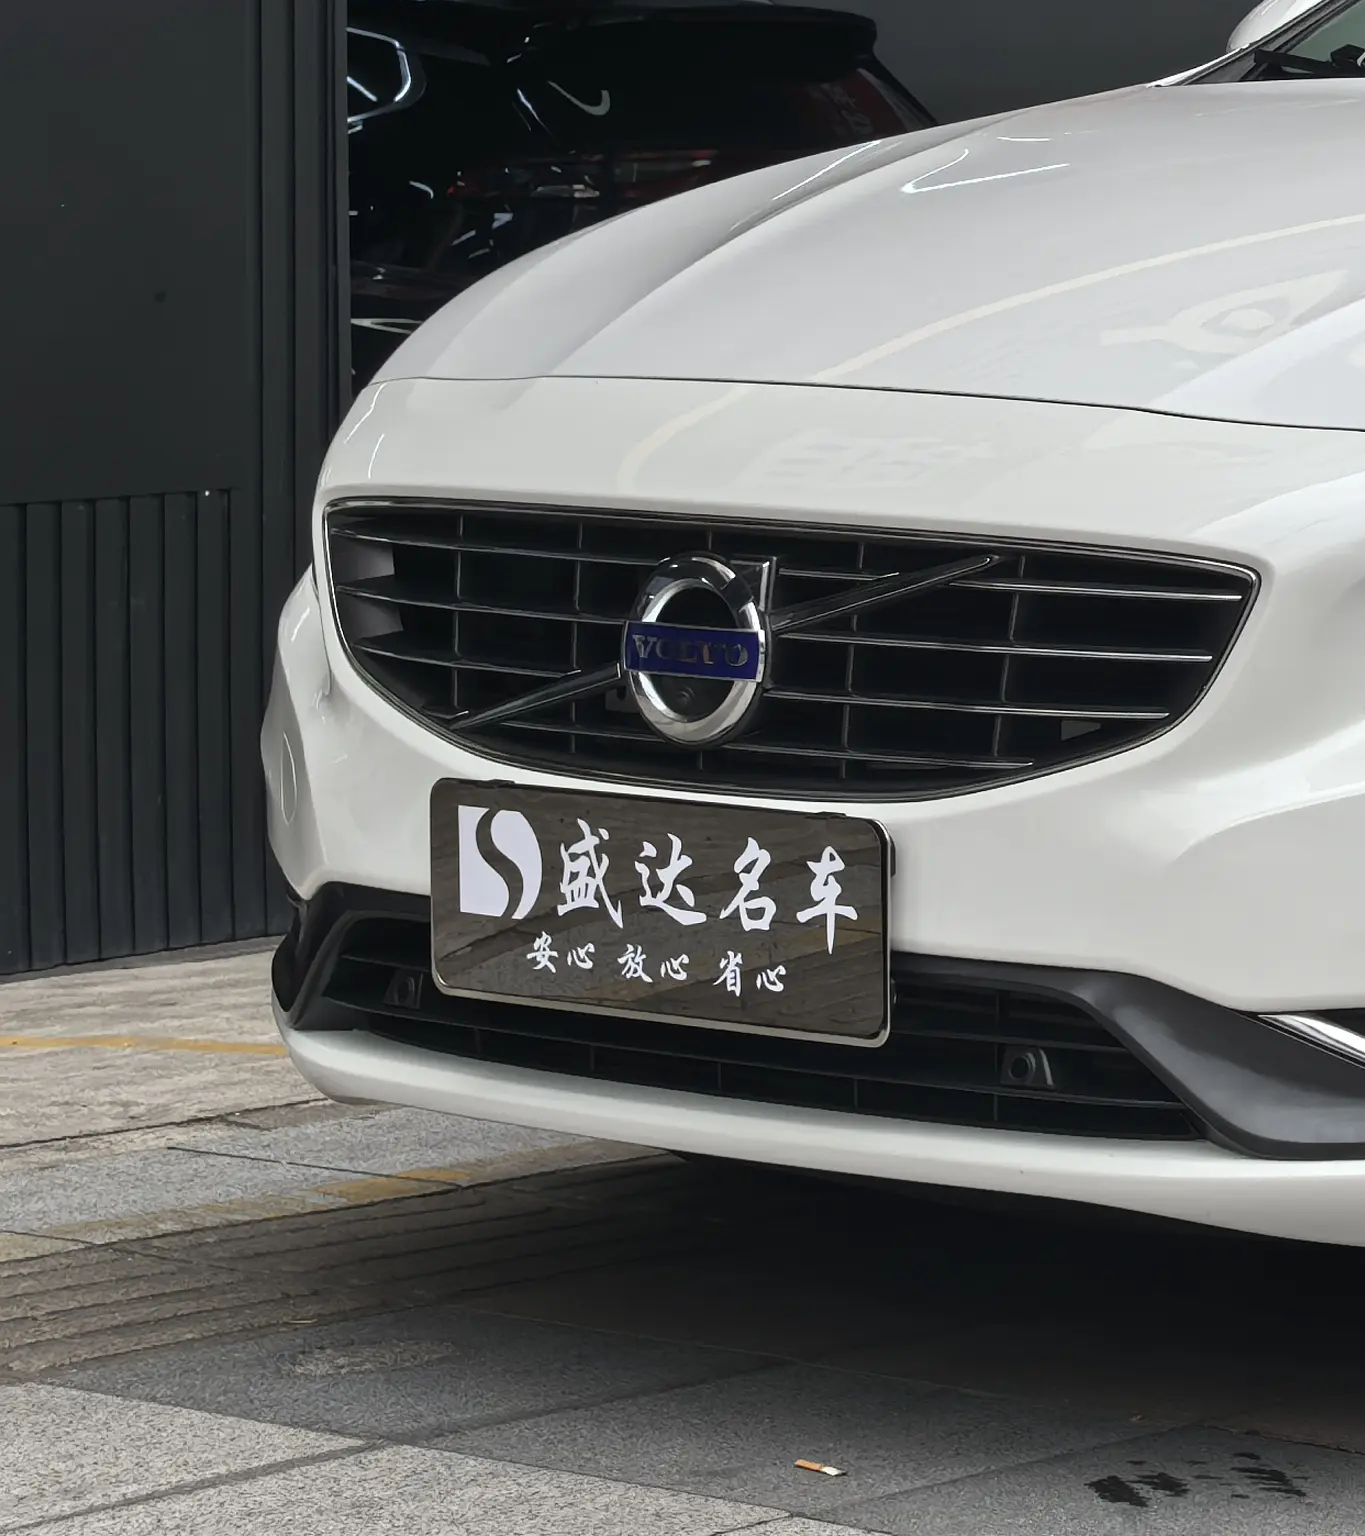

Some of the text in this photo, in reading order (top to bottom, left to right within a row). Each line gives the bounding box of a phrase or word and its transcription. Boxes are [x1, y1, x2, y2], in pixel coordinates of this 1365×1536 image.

[632, 634, 748, 667] VOLVO
[556, 817, 858, 954] 盛达名车
[526, 931, 786, 997] 安心 放心 省心
